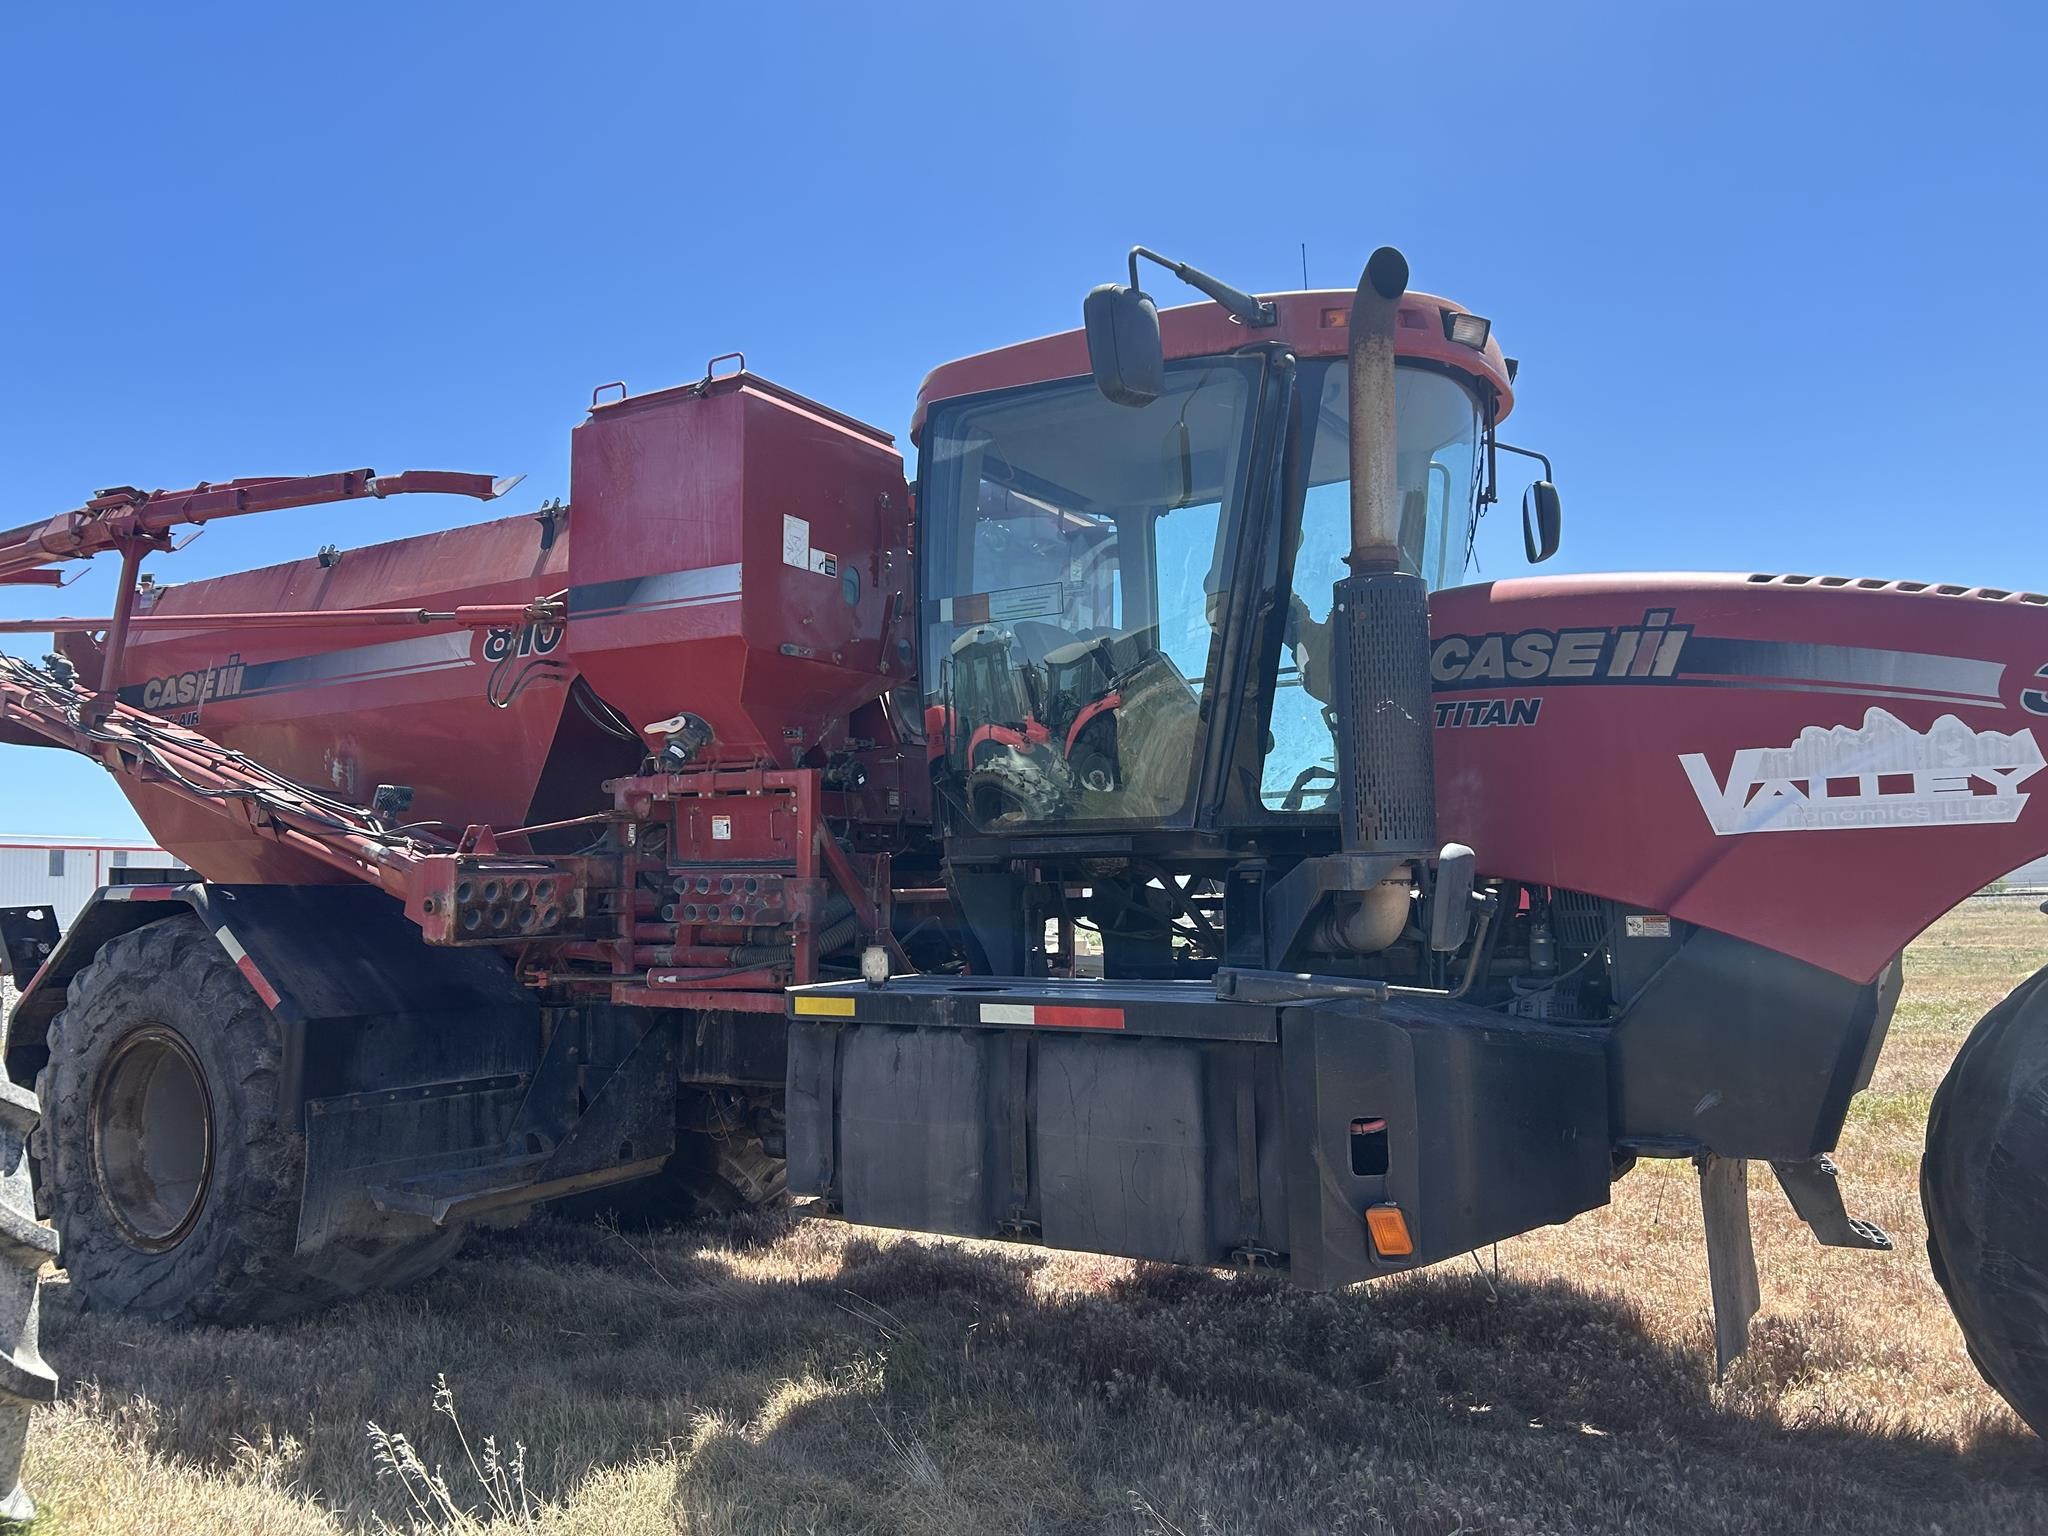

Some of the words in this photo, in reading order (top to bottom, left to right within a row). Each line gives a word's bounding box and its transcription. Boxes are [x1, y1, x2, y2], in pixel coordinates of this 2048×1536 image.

[483, 623, 564, 662] 810
[1431, 631, 1606, 682] CASE
[143, 669, 216, 709] CASE
[1434, 697, 1543, 728] TITAN
[1678, 732, 2047, 836] VALLEY
